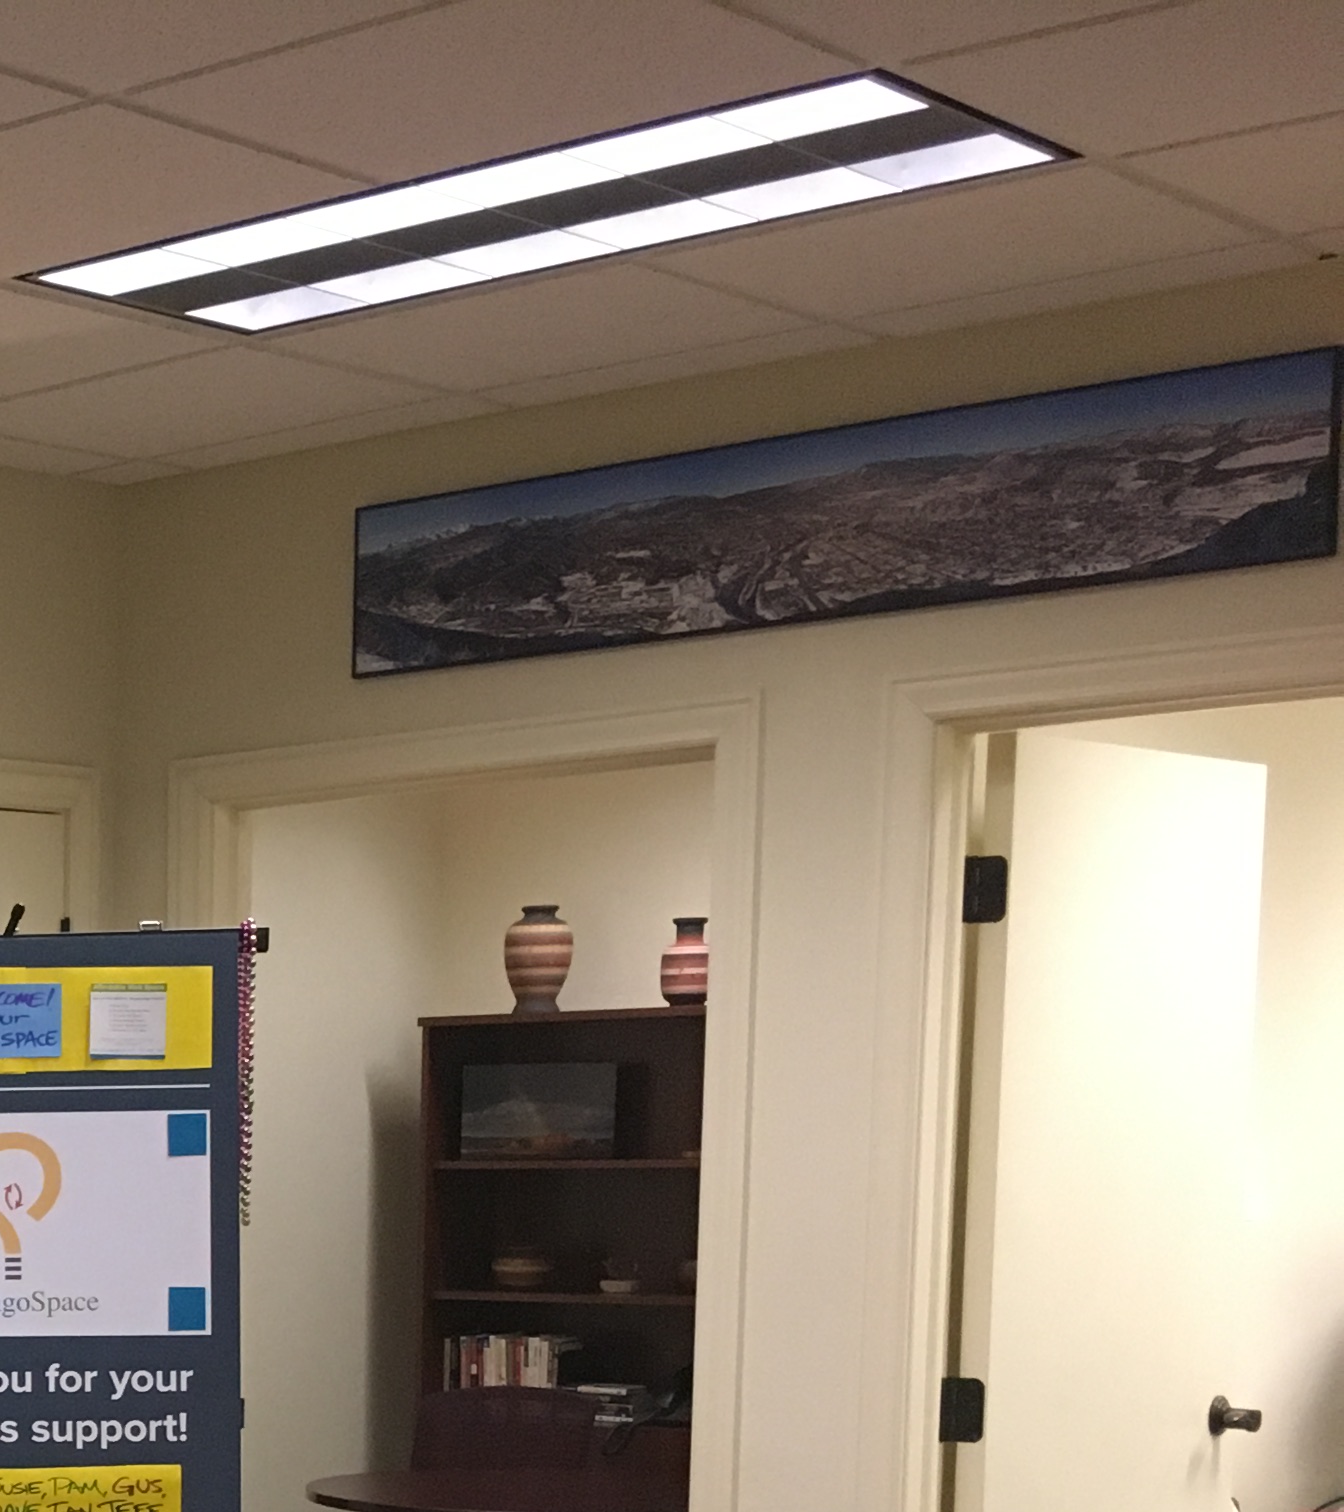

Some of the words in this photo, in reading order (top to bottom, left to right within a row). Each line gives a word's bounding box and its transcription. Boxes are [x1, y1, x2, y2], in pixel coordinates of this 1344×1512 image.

[1, 1031, 58, 1048] SPACE
[45, 1364, 97, 1392] for
[110, 1370, 193, 1400] your
[31, 1413, 188, 1450] support!
